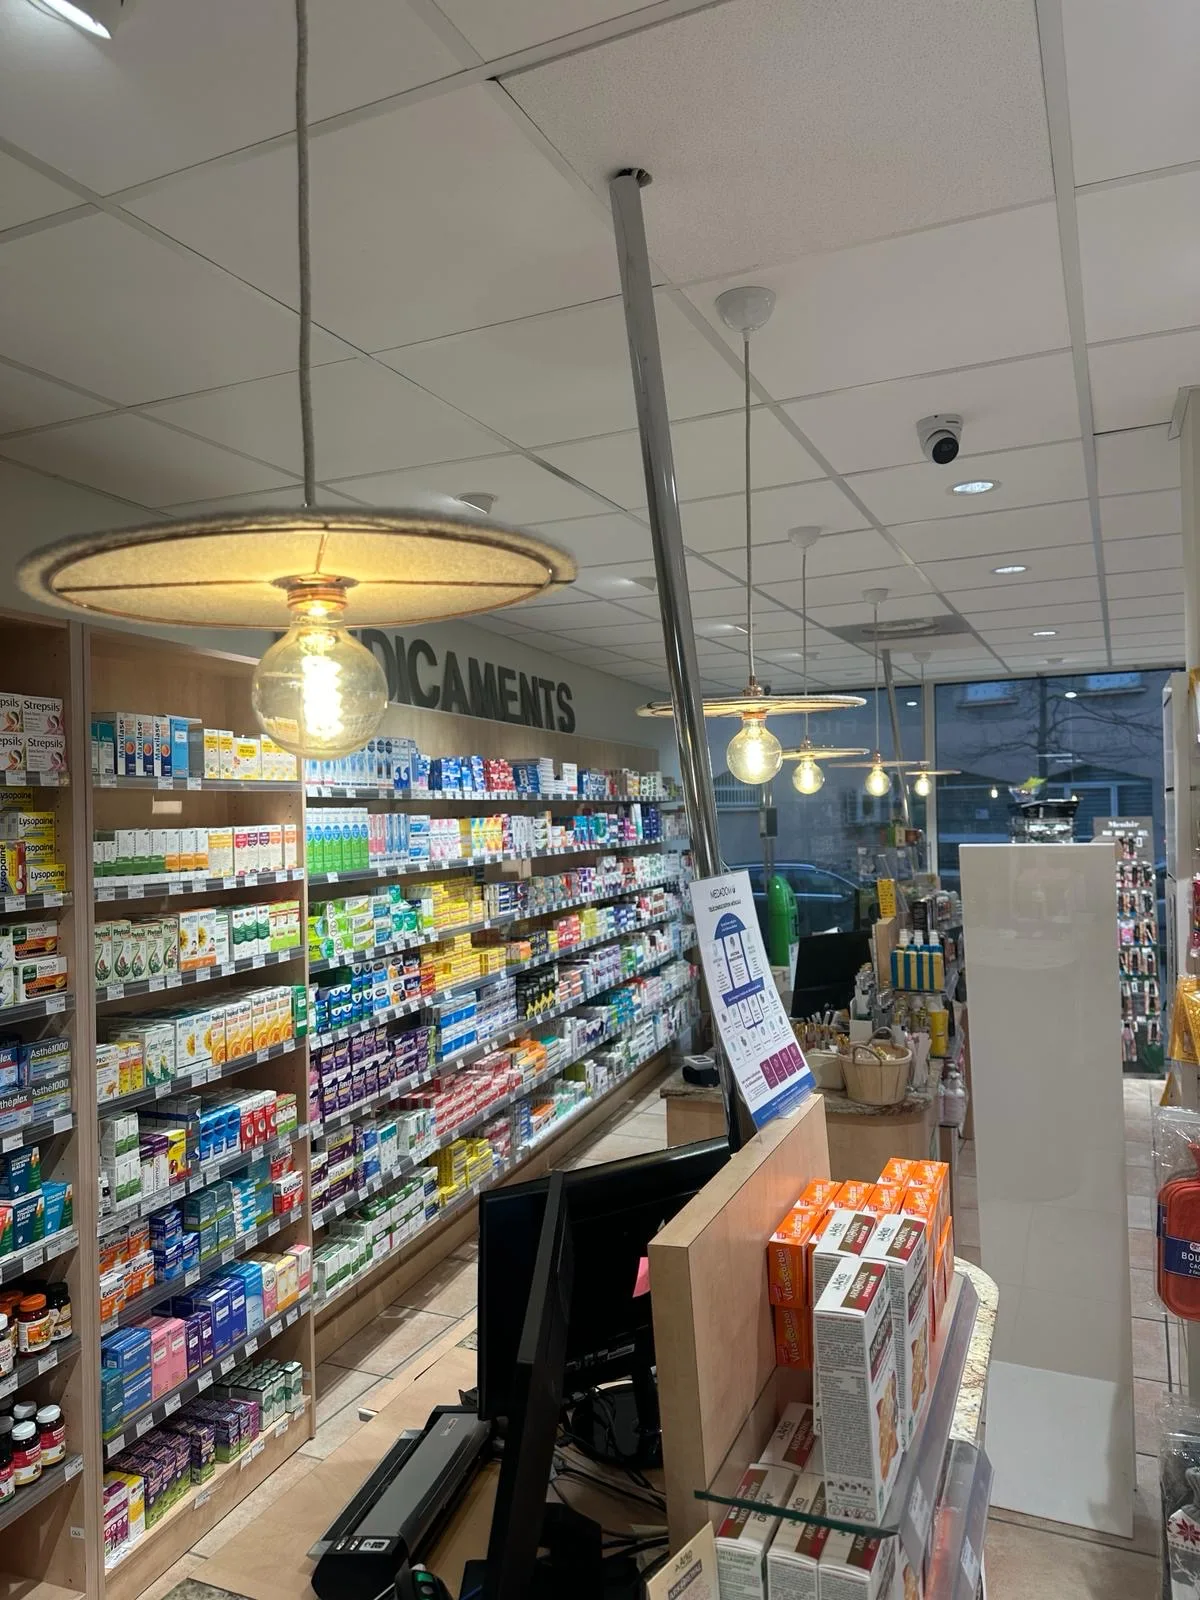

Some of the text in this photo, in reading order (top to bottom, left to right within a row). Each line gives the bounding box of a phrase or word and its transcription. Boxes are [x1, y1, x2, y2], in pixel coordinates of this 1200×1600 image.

[348, 627, 576, 734] DICAMENTS
[24, 700, 60, 712] Strepsils
[28, 738, 63, 749] Strepsils
[31, 1041, 69, 1058] Asthé1000
[32, 1079, 69, 1096] Asthé1000
[102, 1284, 123, 1299] Exomuc
